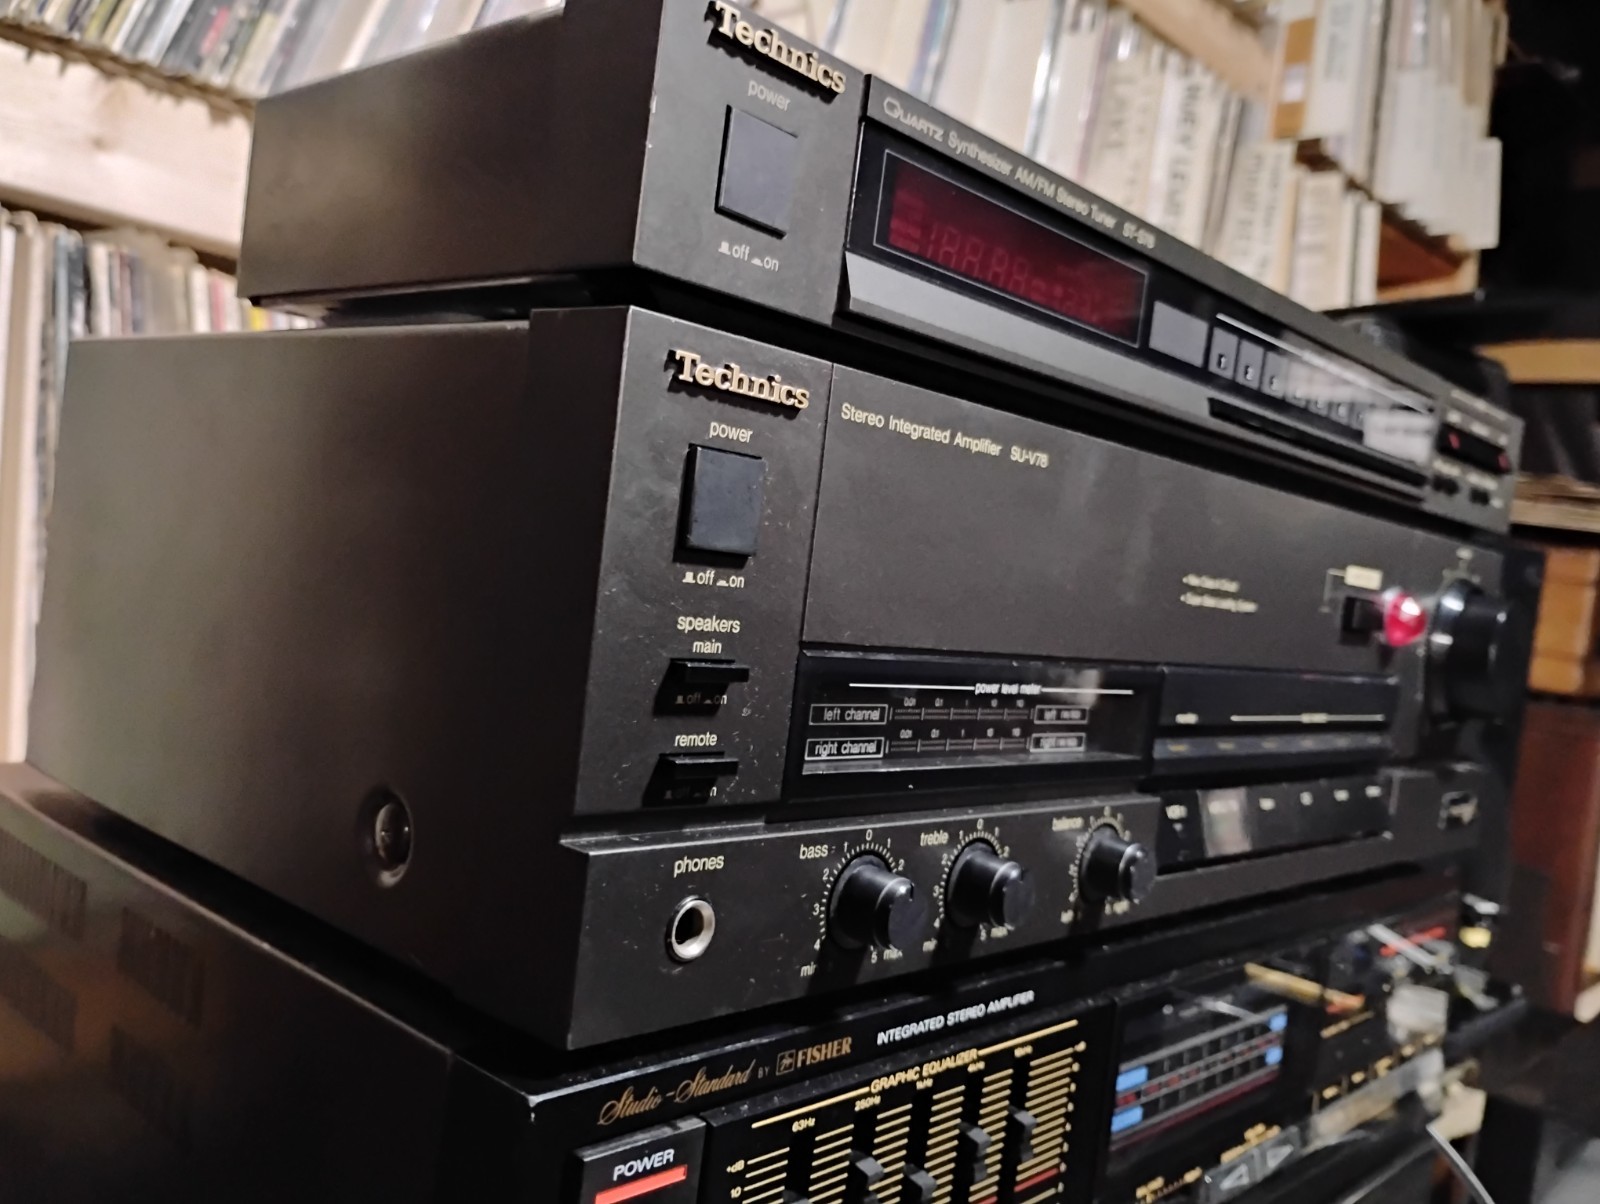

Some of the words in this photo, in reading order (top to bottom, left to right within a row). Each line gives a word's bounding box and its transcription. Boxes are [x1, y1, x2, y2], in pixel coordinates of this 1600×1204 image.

[715, 1, 847, 94] Technics
[748, 80, 791, 112] power
[1014, 166, 1057, 198] AM/FM
[732, 244, 750, 261] off
[763, 256, 779, 272] on
[675, 350, 810, 409] Technics
[709, 421, 754, 444] power
[841, 402, 885, 428] Stereo
[889, 415, 951, 444] Integrated
[953, 431, 1002, 457] Amplifier
[697, 569, 715, 586] off
[729, 575, 745, 588] on
[677, 615, 741, 634] speakers
[692, 638, 722, 654] main
[975, 683, 1000, 695] power
[823, 707, 841, 721] left
[844, 707, 881, 721] channel
[674, 731, 718, 747] remote
[815, 741, 839, 757] right
[841, 740, 877, 754] channel
[977, 818, 984, 830] 0
[865, 829, 873, 841] 0
[887, 838, 892, 848] 1
[920, 830, 949, 847] treble
[800, 844, 829, 859] bass
[843, 841, 849, 852] 1
[674, 853, 725, 878] phones
[897, 859, 905, 871] 2
[823, 868, 830, 880] 2
[813, 903, 820, 916] 3
[814, 938, 821, 950] 4
[877, 1014, 945, 1045] INTEGRATED
[947, 1003, 986, 1027] STEREO
[987, 989, 1035, 1014] AMPLIFIER
[757, 1066, 770, 1079] BY
[797, 1036, 852, 1068] FISHER
[871, 1066, 920, 1094] GRAPHIC
[922, 1048, 978, 1078] EQUALIZER
[792, 1117, 816, 1132] 63Hz
[613, 1148, 675, 1181] POWER
[730, 1186, 742, 1199] 10
